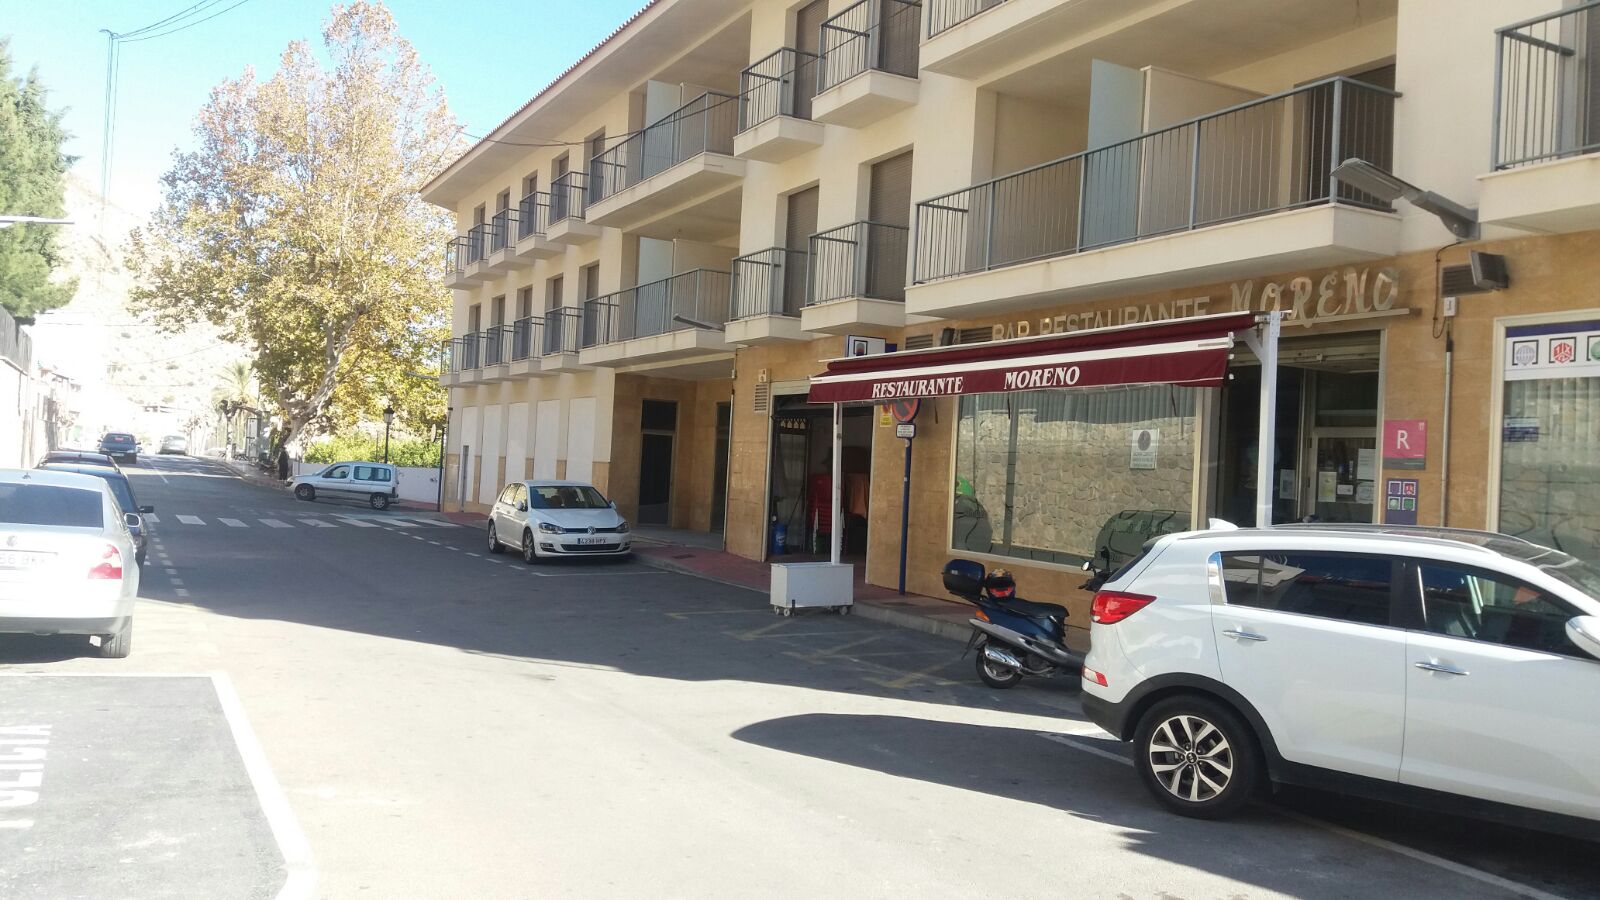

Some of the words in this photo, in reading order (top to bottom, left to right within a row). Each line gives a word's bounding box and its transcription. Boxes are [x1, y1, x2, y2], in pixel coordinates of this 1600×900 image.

[1230, 266, 1401, 328] MORENO
[871, 376, 965, 399] RESTAURANTE
[1003, 366, 1080, 390] MORENO
[1396, 429, 1411, 450] R
